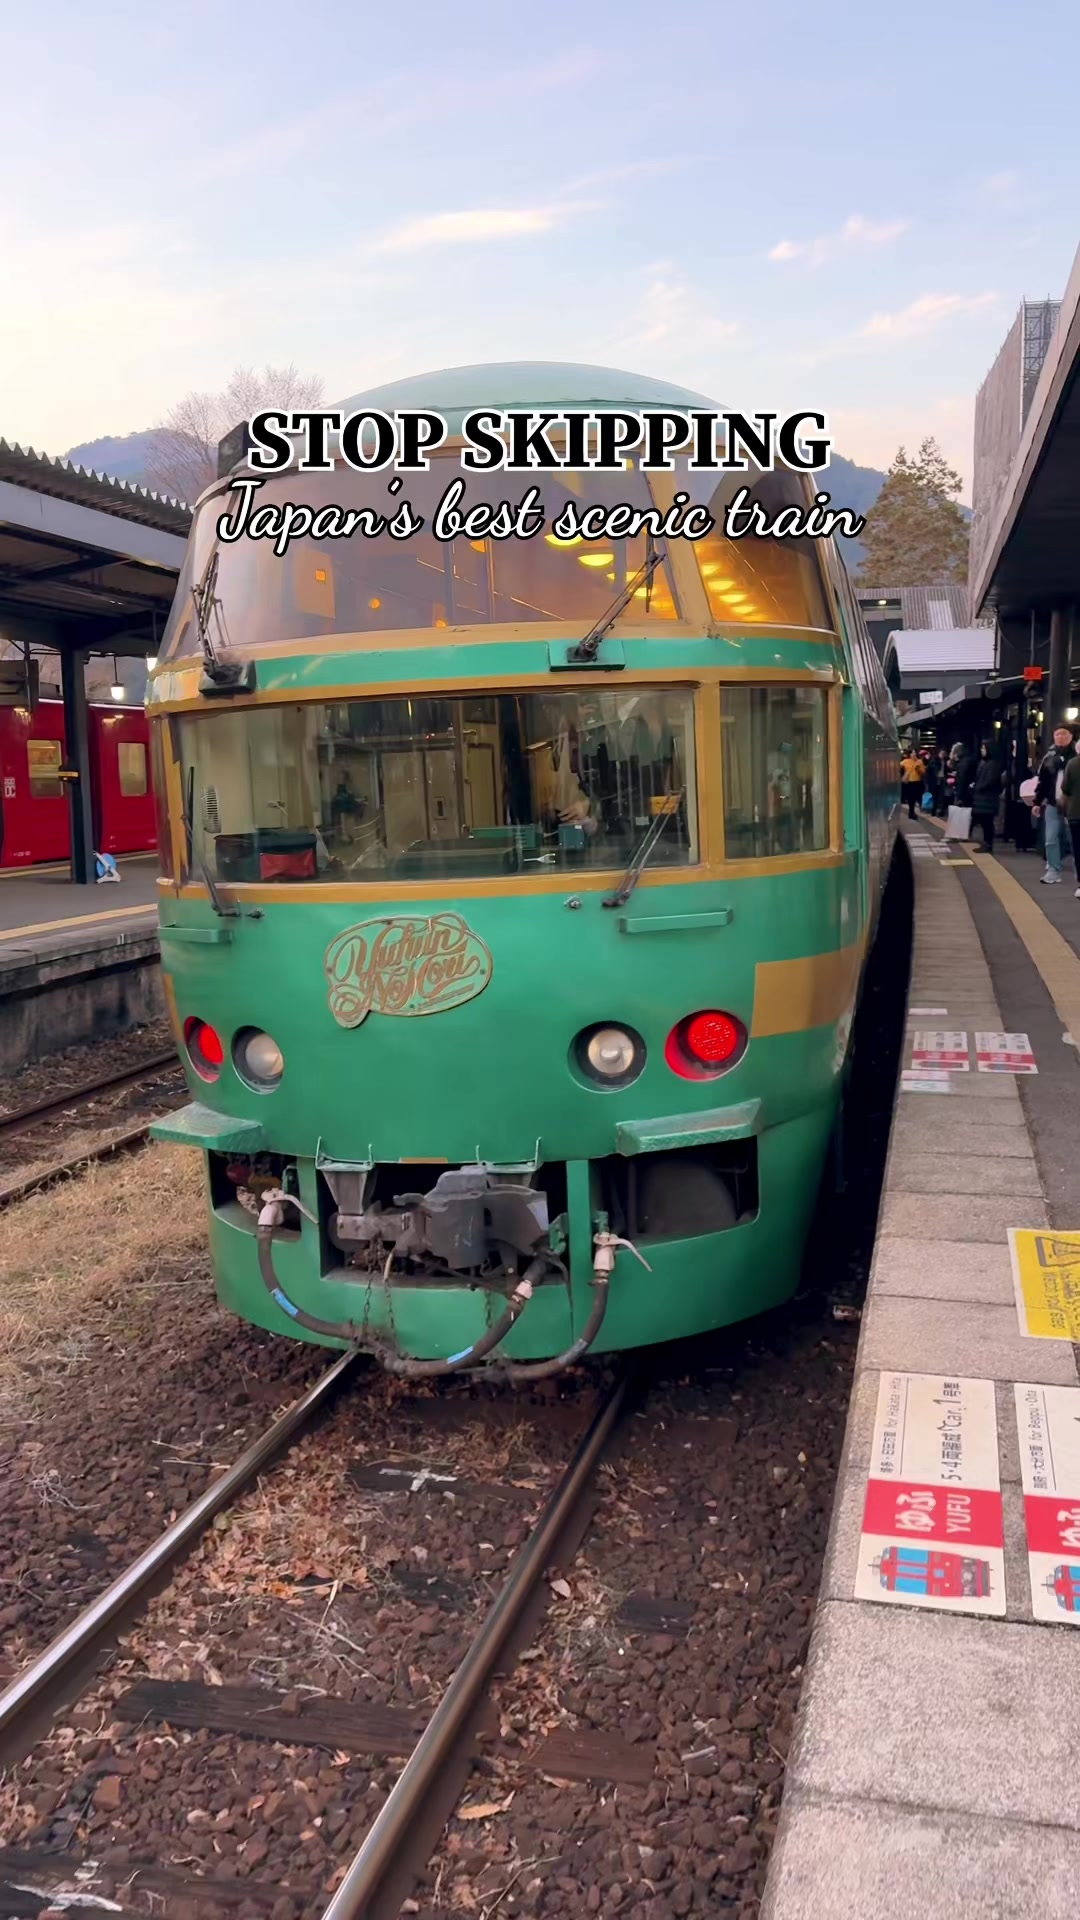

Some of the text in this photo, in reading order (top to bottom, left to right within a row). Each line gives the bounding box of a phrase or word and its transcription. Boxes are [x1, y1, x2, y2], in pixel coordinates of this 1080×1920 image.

[333, 914, 468, 983] Yufuin
[1029, 1430, 1043, 1442] for
[895, 1490, 937, 1533] ゆふ
[945, 1493, 972, 1534] YUFU
